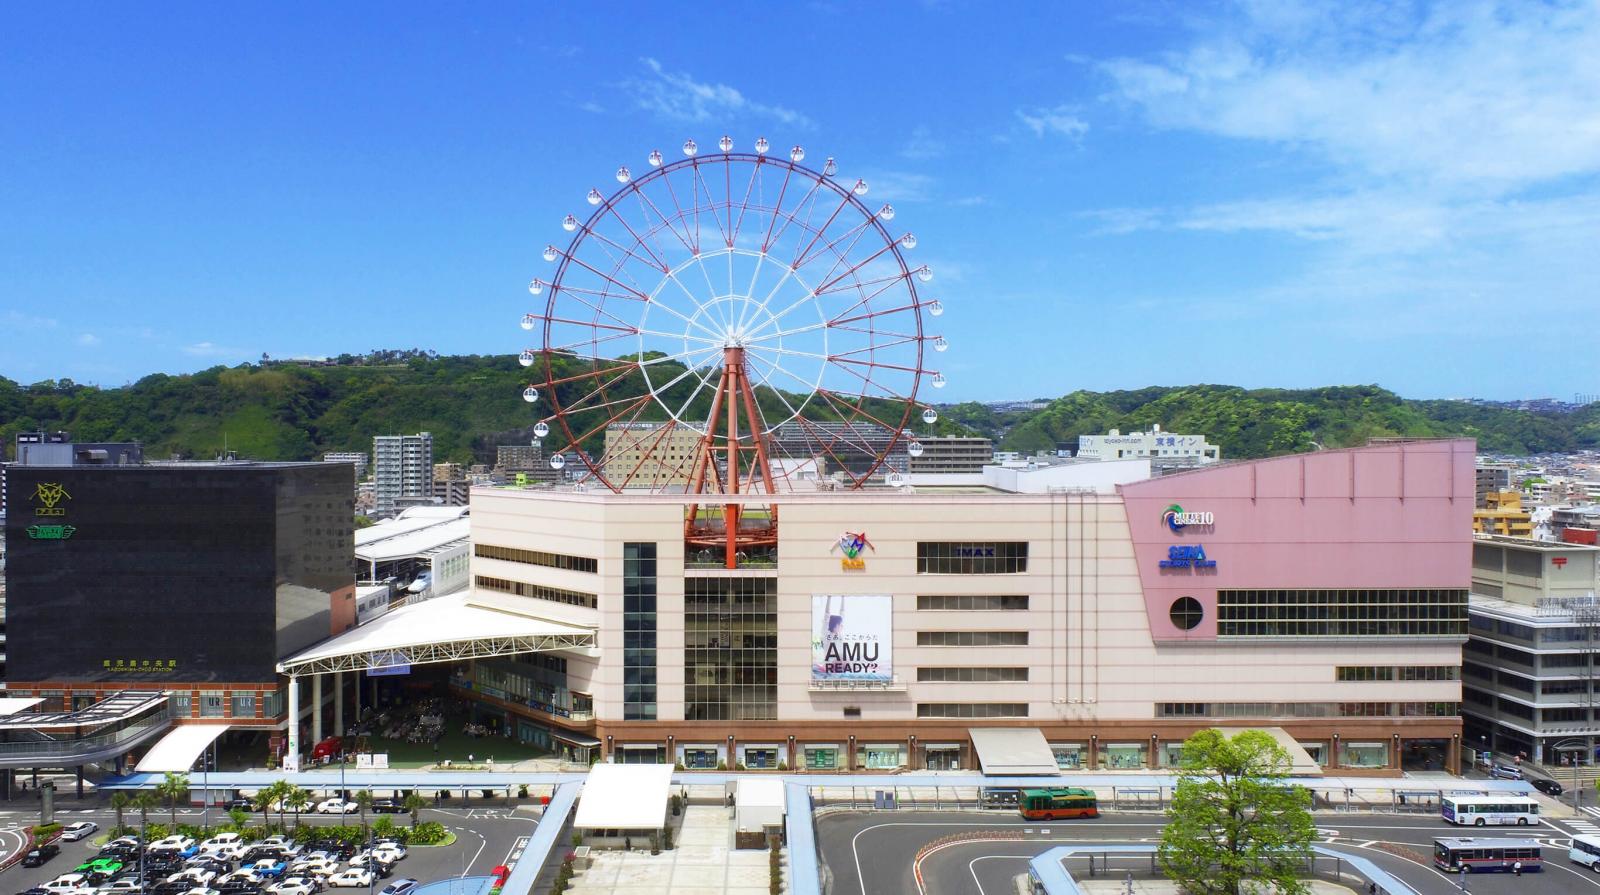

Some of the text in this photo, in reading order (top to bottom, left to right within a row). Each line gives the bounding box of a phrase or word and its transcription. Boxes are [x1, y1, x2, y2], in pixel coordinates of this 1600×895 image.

[1156, 437, 1197, 446] 東横イン
[1200, 511, 1214, 525] 10
[957, 548, 994, 557] IMAX
[824, 642, 879, 662] AMU
[825, 663, 878, 673] READY?
